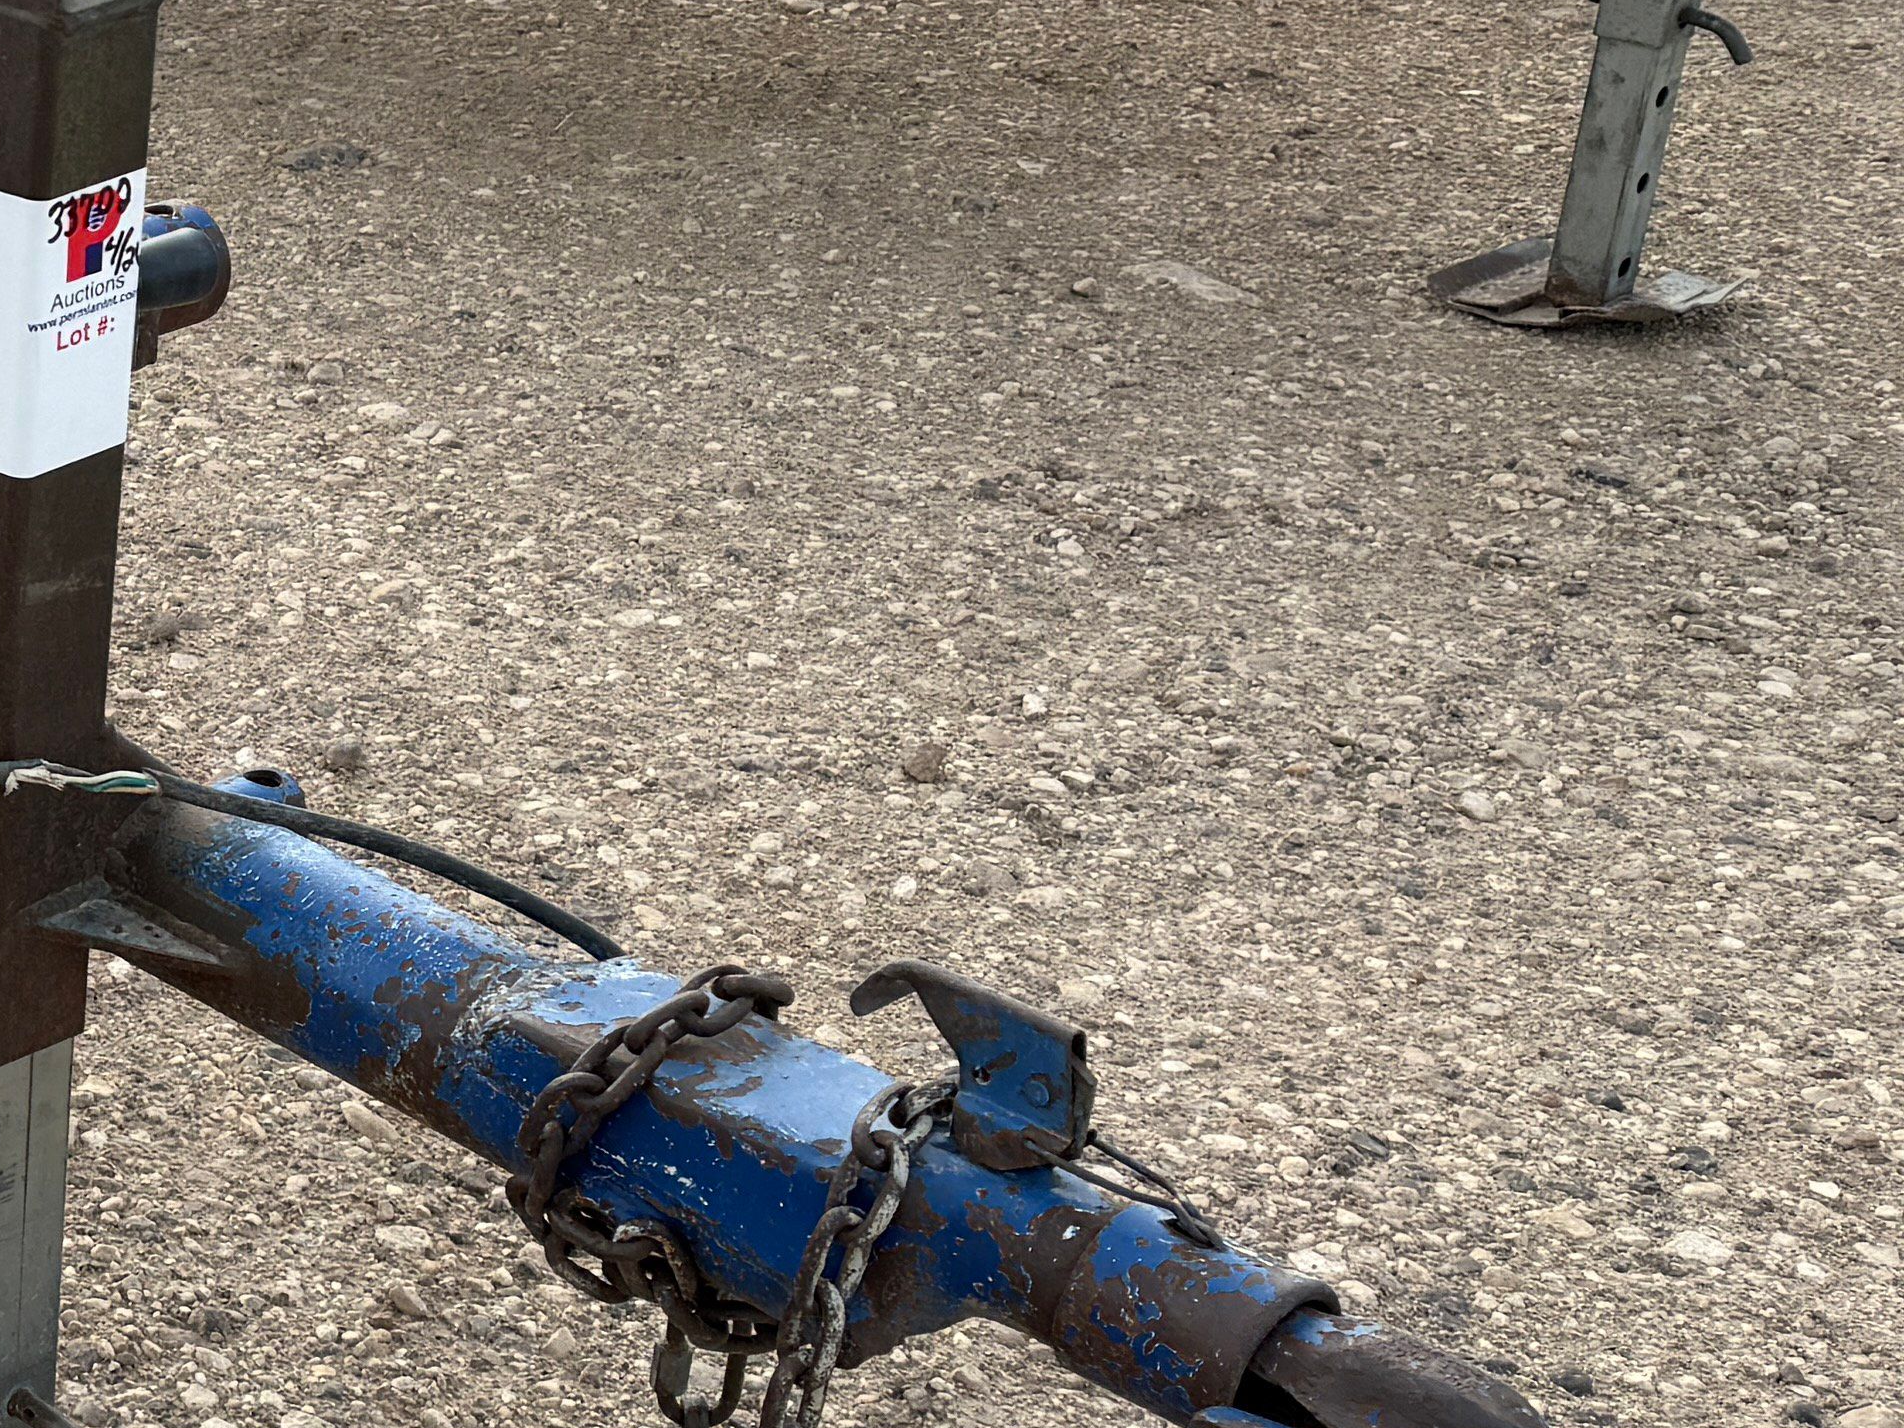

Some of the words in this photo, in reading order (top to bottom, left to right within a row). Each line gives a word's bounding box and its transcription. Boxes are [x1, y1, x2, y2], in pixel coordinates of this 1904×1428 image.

[104, 226, 141, 276] 4/2
[50, 274, 126, 313] Auctions
[56, 322, 91, 352] Lot
